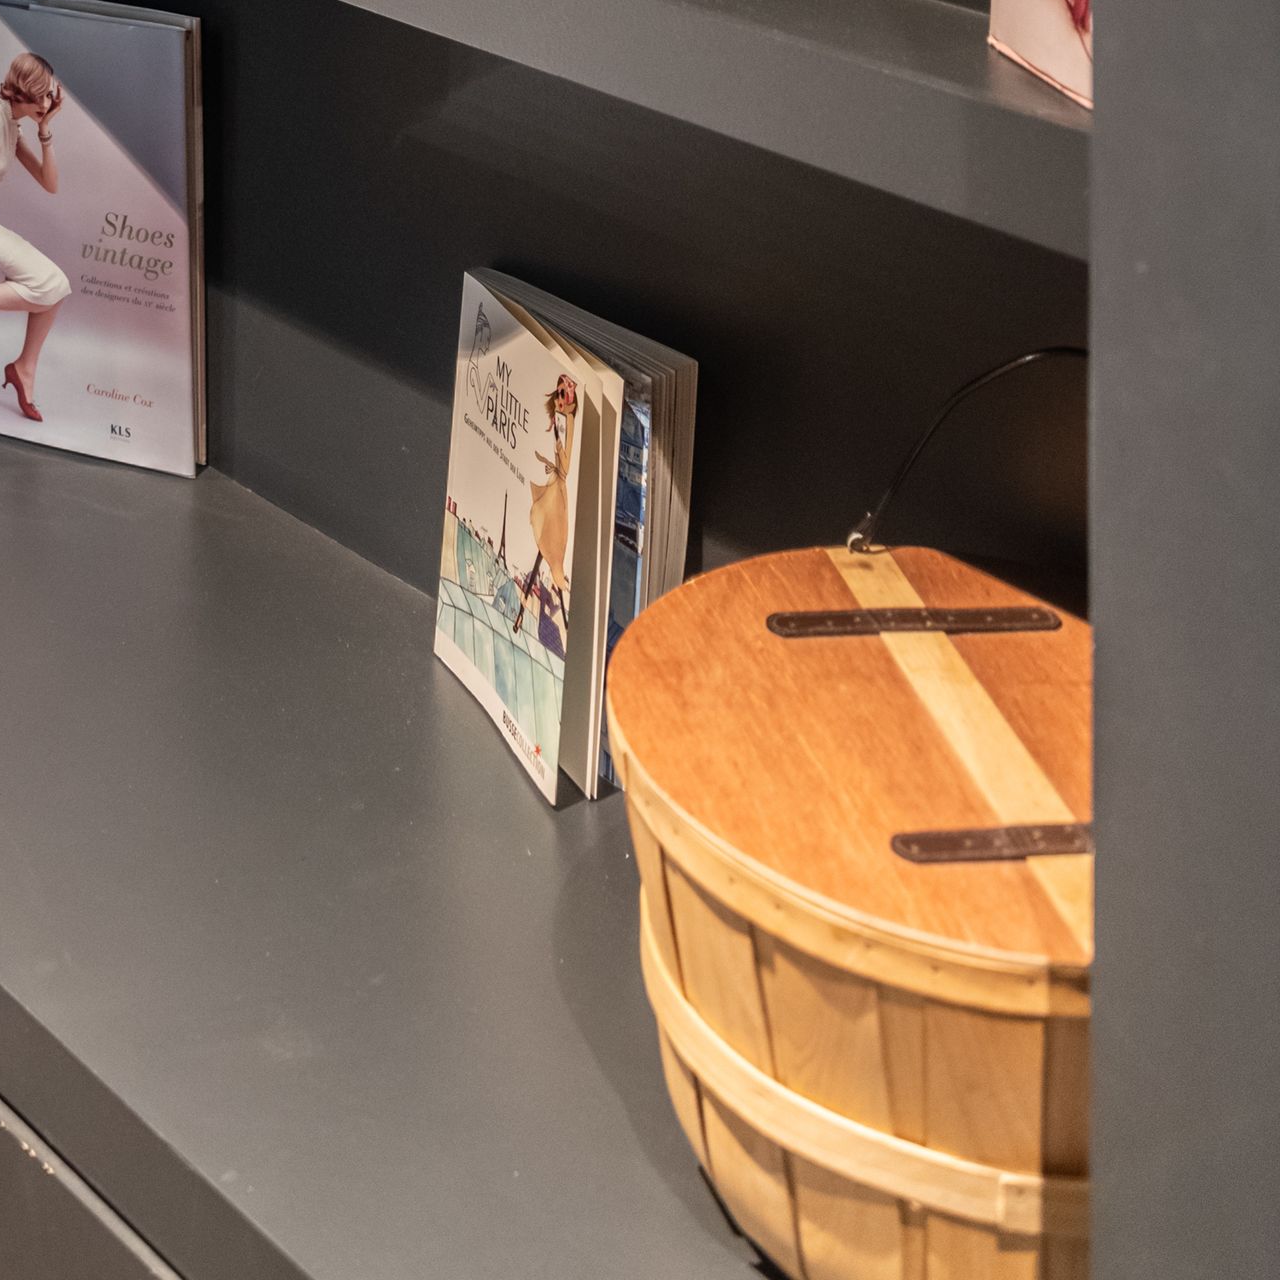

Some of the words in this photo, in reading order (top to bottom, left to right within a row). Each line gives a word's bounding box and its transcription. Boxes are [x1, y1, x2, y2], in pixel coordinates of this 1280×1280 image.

[101, 212, 175, 249] Shoes
[81, 238, 173, 281] vintage
[80, 274, 122, 290] Collections
[134, 286, 170, 300] créations
[81, 286, 93, 296] des
[94, 289, 130, 304] designers
[132, 296, 142, 305] du
[155, 302, 176, 313] siècle
[496, 355, 512, 387] MY
[86, 383, 130, 401] Caroline
[133, 394, 155, 408] Cox
[500, 384, 529, 434] LITTLE
[110, 423, 132, 438] KLS
[486, 392, 517, 450] PARIS
